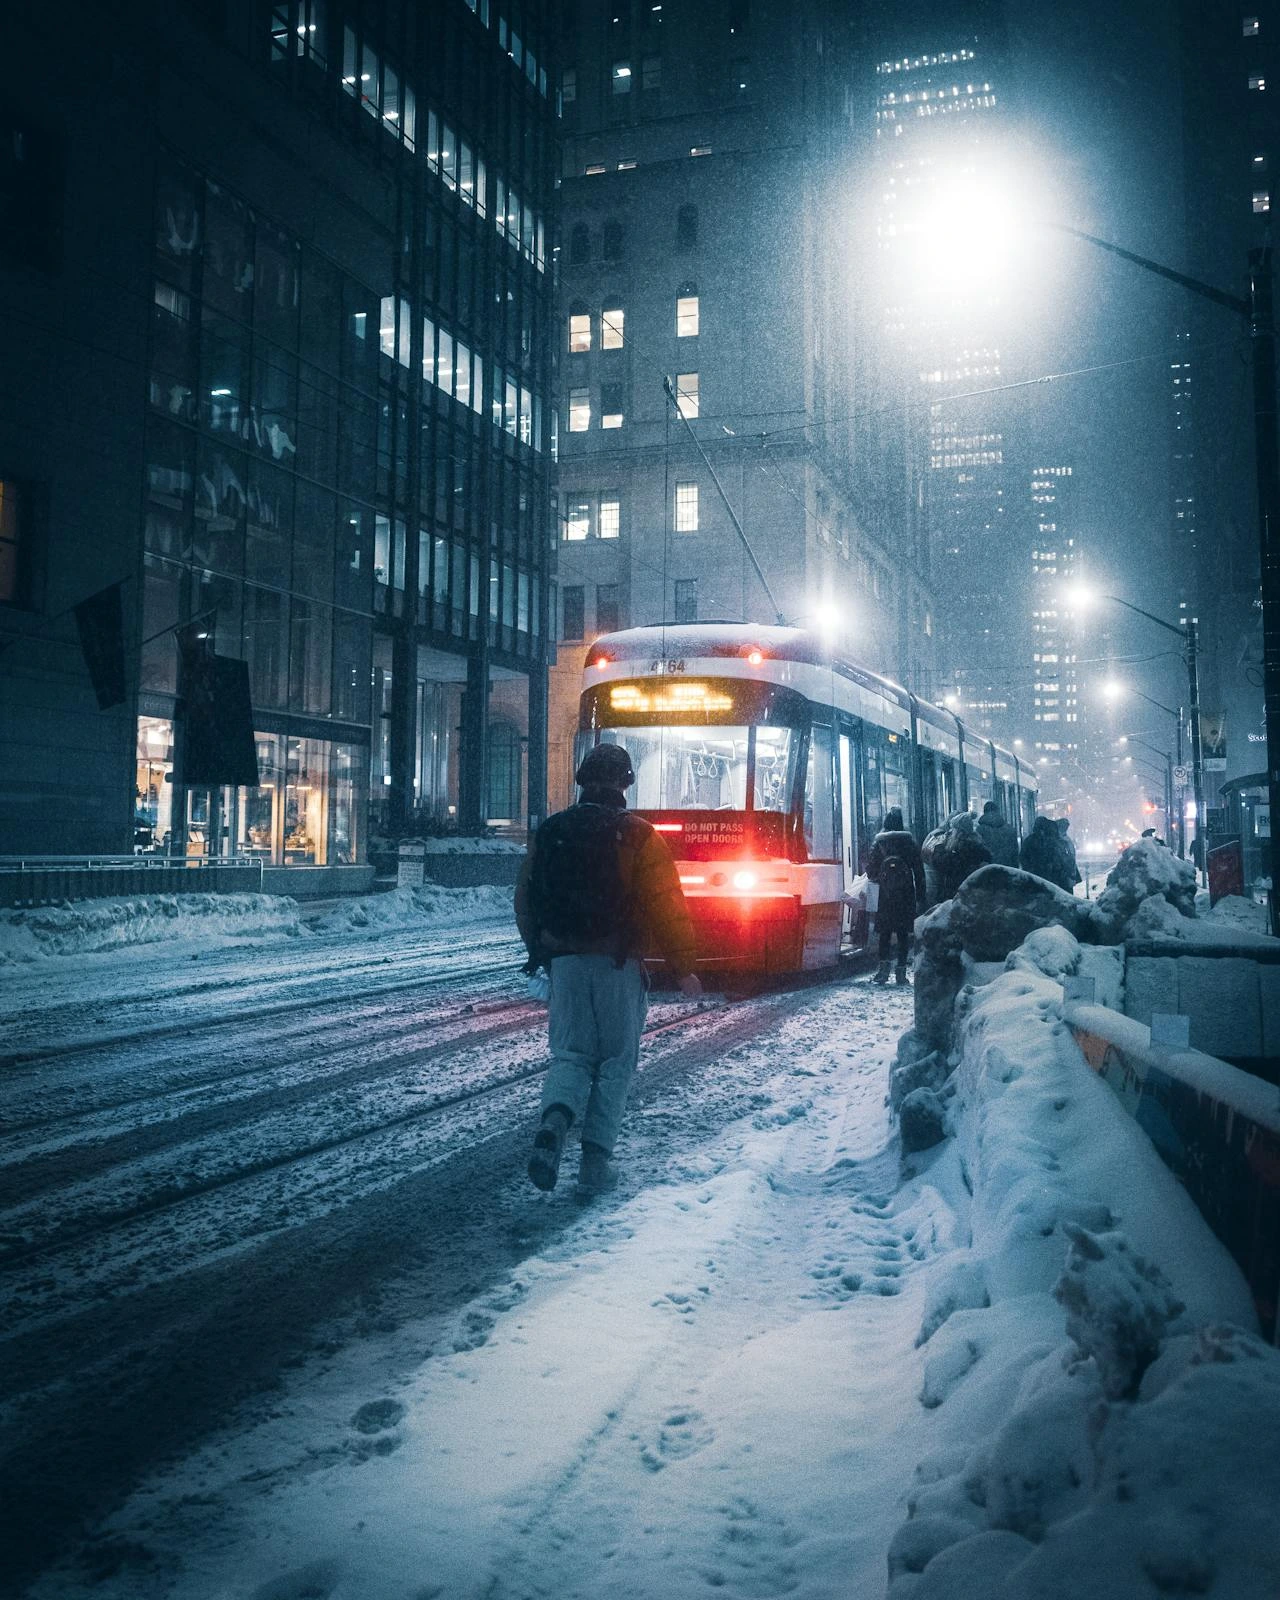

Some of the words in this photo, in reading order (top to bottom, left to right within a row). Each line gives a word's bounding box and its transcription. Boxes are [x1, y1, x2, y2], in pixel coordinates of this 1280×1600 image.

[1248, 734, 1267, 742] Sco
[685, 823, 697, 832] DO
[700, 823, 718, 832] NOT
[720, 823, 744, 832] PASS
[685, 834, 709, 843] OPEN
[712, 834, 744, 844] DOORS
